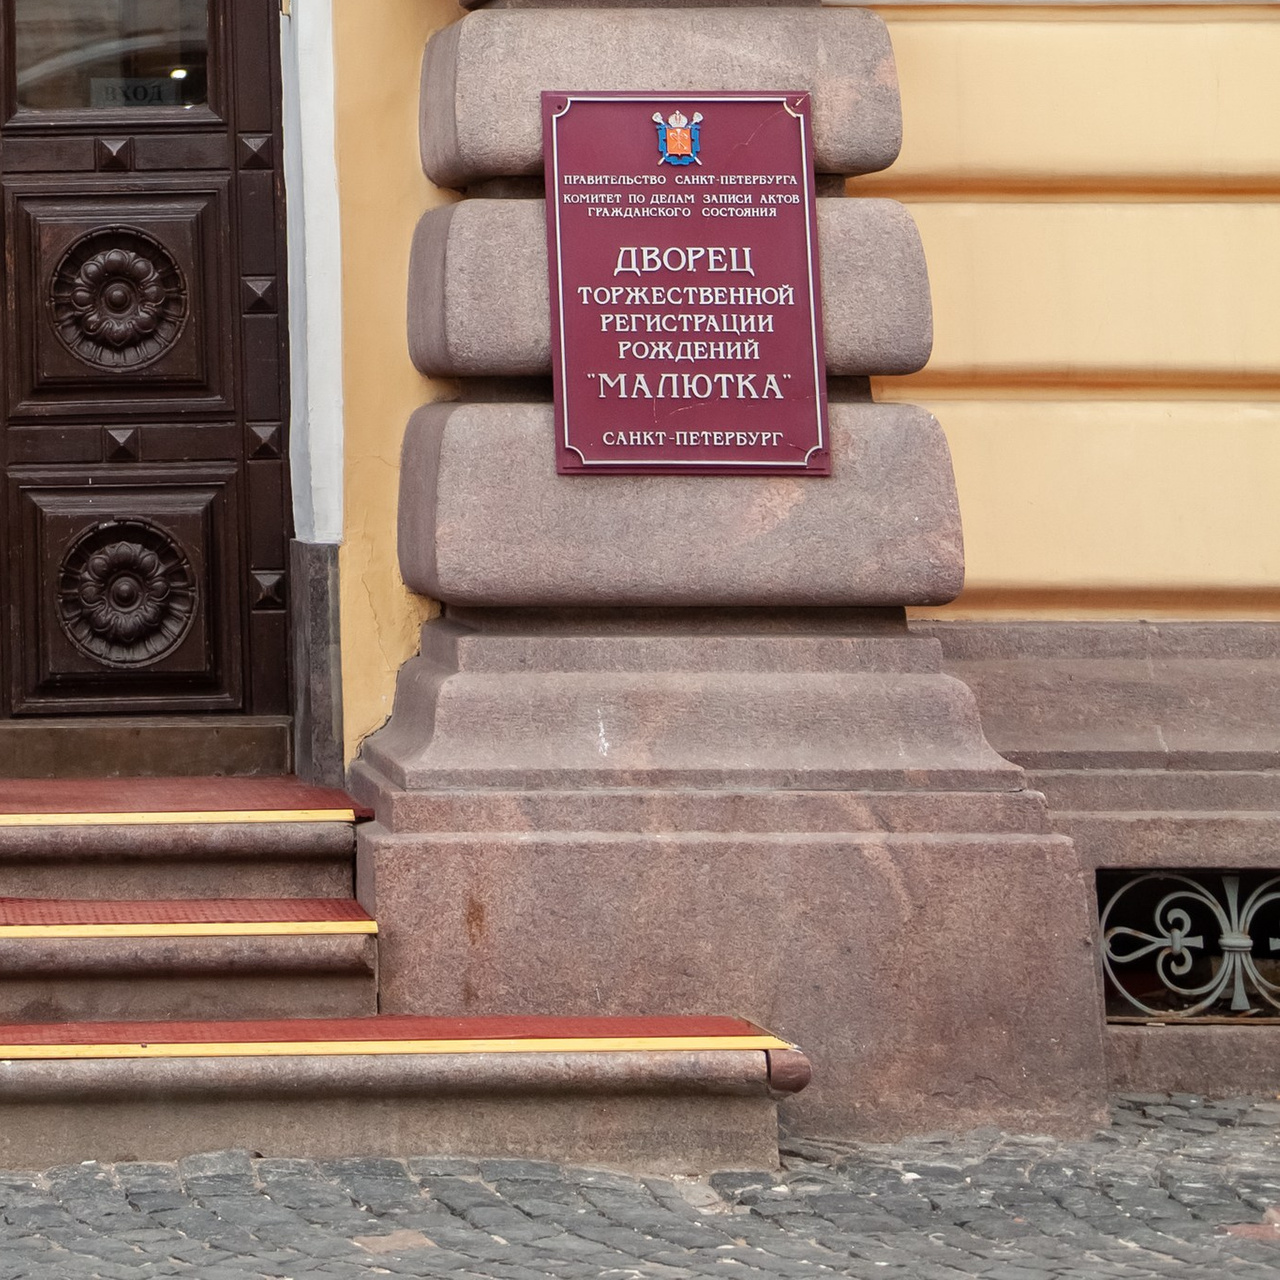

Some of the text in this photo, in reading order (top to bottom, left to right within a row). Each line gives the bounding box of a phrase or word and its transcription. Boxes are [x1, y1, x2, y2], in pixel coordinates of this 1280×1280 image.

[104, 85, 163, 104] ВХОД
[564, 175, 797, 184] ПРАВИТЕЛЬСТВО САНКТ-ПЕТЕРБУРГА
[564, 194, 799, 204] КОМИТЕТ ПО ДЕЛАМ ЗАПИСИ АКТОВ
[588, 208, 776, 218] ГРАЖДАНСКОГО СОСТОЯНИЯ
[614, 247, 754, 276] ДВОРЕЦ
[578, 284, 794, 304] ТОРЖЕСТВЕННОЙ
[600, 314, 773, 335] РЕГИСТРАЦИИ
[618, 339, 759, 362] РОЖДЕНИЙ
